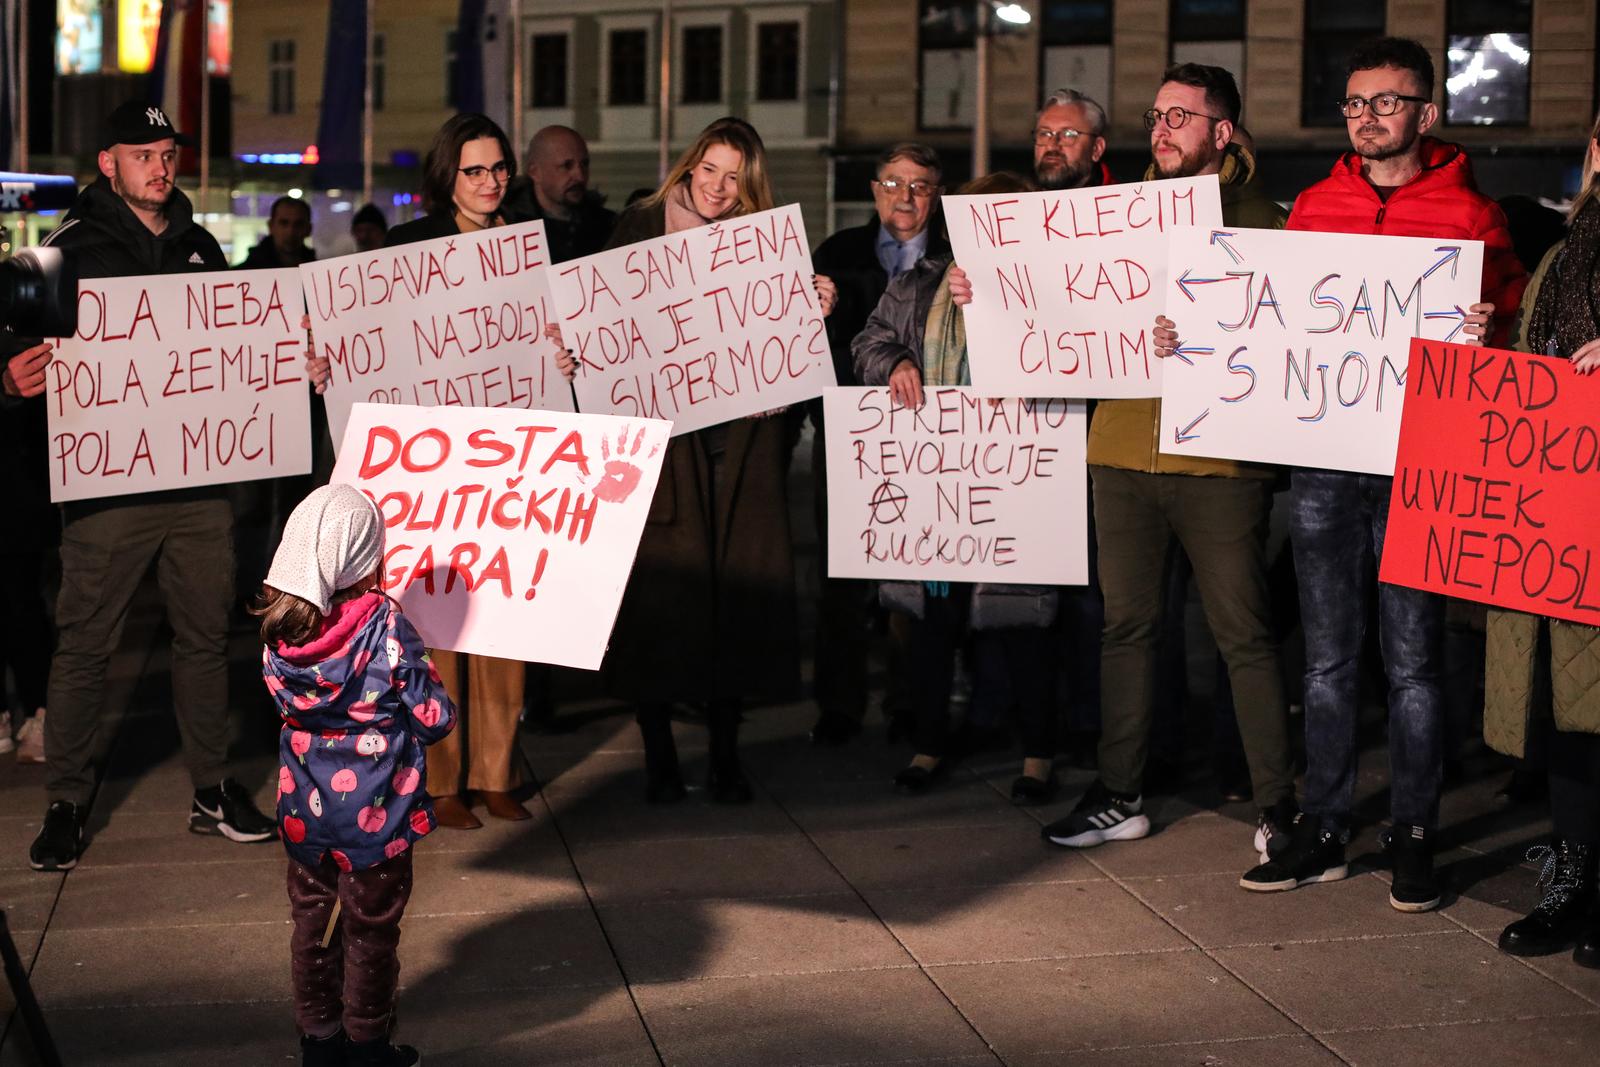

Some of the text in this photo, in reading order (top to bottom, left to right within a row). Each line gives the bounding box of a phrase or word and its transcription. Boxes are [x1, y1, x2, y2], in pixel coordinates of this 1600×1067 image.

[970, 185, 1194, 248] NE KLEČIM
[311, 232, 543, 321] USISAVAČ NIJE
[560, 214, 803, 321] JA SAM ŽENA
[996, 258, 1151, 311] NI KAD
[56, 279, 290, 348] OLA NEBA
[575, 270, 813, 377] KOJA JE TVOJA
[1217, 271, 1422, 341] JA SAM
[325, 296, 548, 386] MOJ NAJBOLJI
[1020, 319, 1150, 379] ČISTIM
[50, 359, 149, 417] POLA
[1220, 346, 1257, 403] S
[1417, 345, 1558, 411] NIKAD
[54, 402, 274, 486] POLA MOĆI
[853, 439, 1058, 485] REVOLUCIJE
[1479, 410, 1600, 474] POKO
[936, 481, 1003, 525] NE
[1401, 467, 1545, 529] UVIJEK
[861, 524, 1017, 566] RUČKOVE
